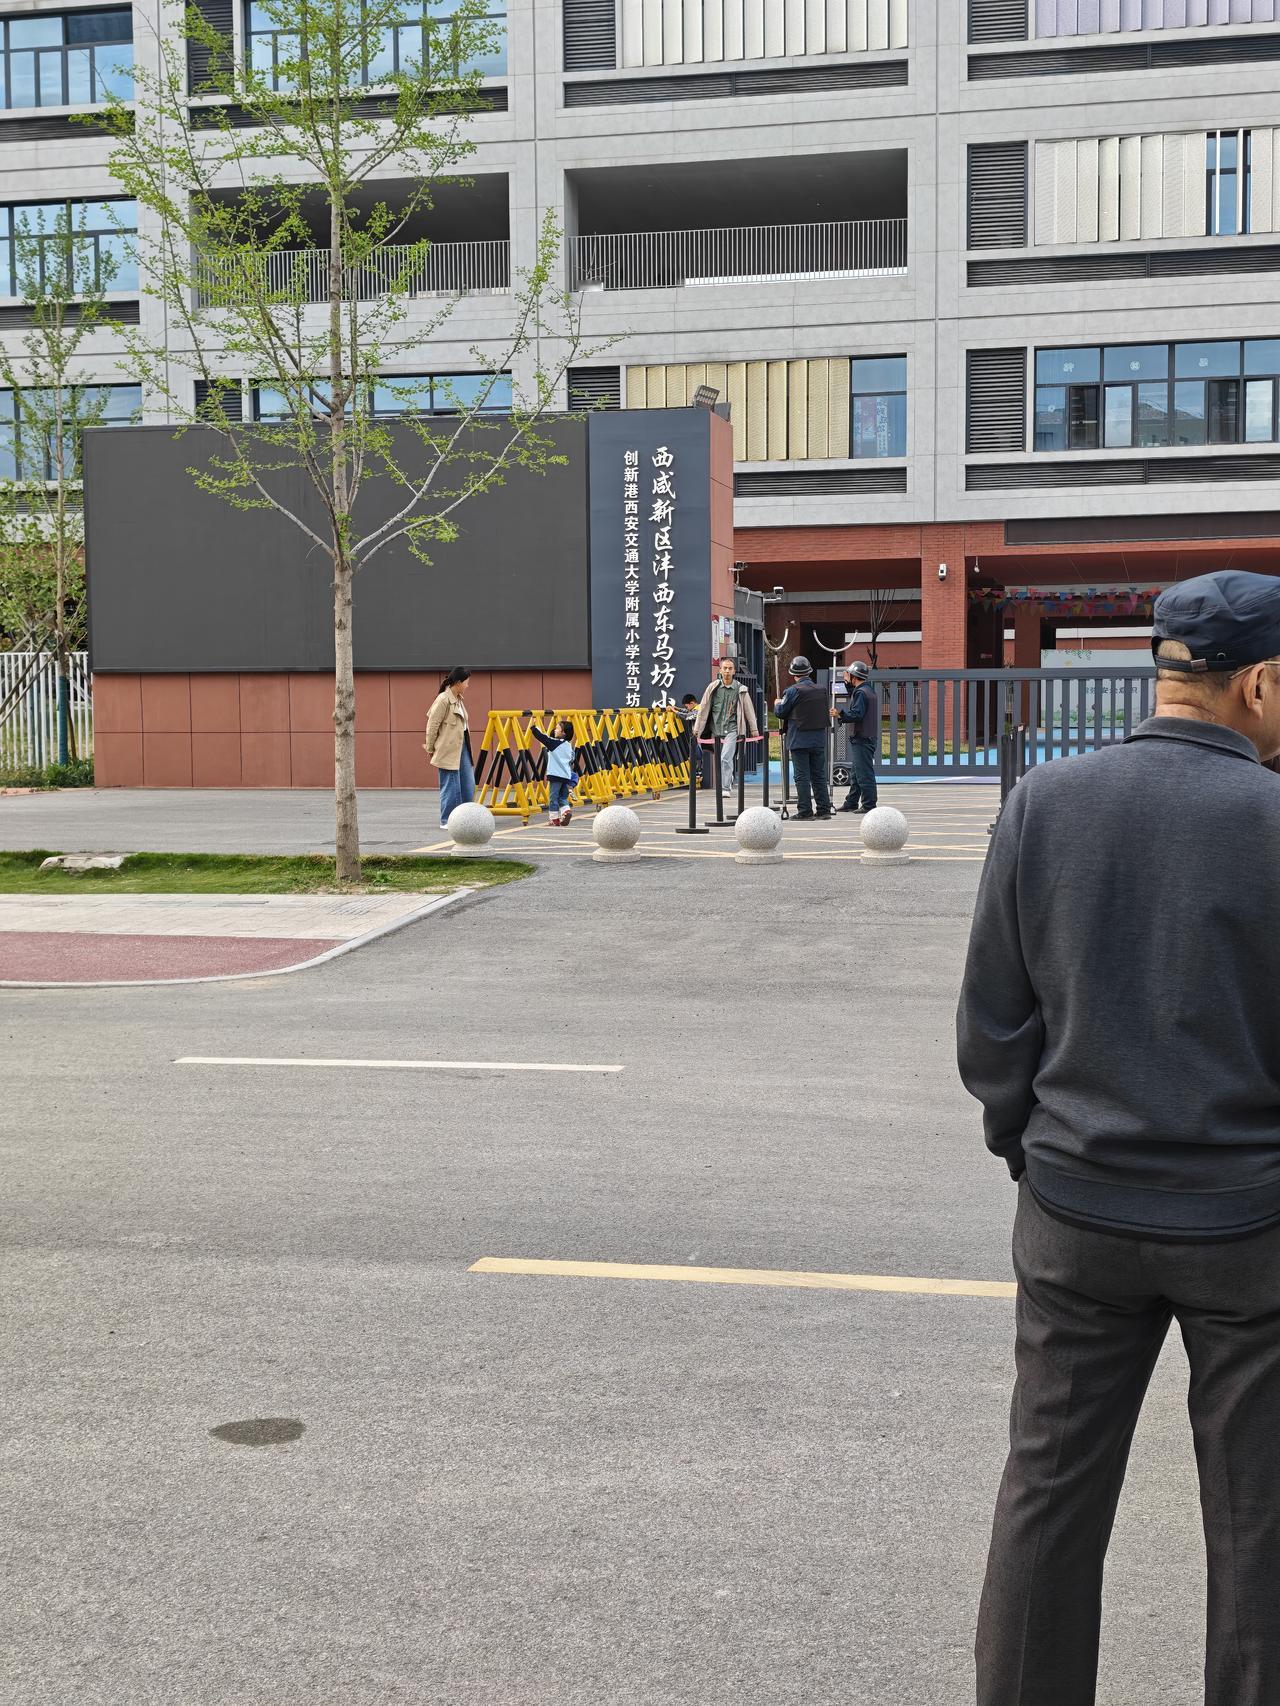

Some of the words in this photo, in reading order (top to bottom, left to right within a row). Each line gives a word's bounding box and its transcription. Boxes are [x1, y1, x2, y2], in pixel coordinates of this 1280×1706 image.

[623, 450, 641, 708] 创新港西安交通大学附属小学东马坊
[648, 446, 677, 732] 西咸新区沣西东马坊小
